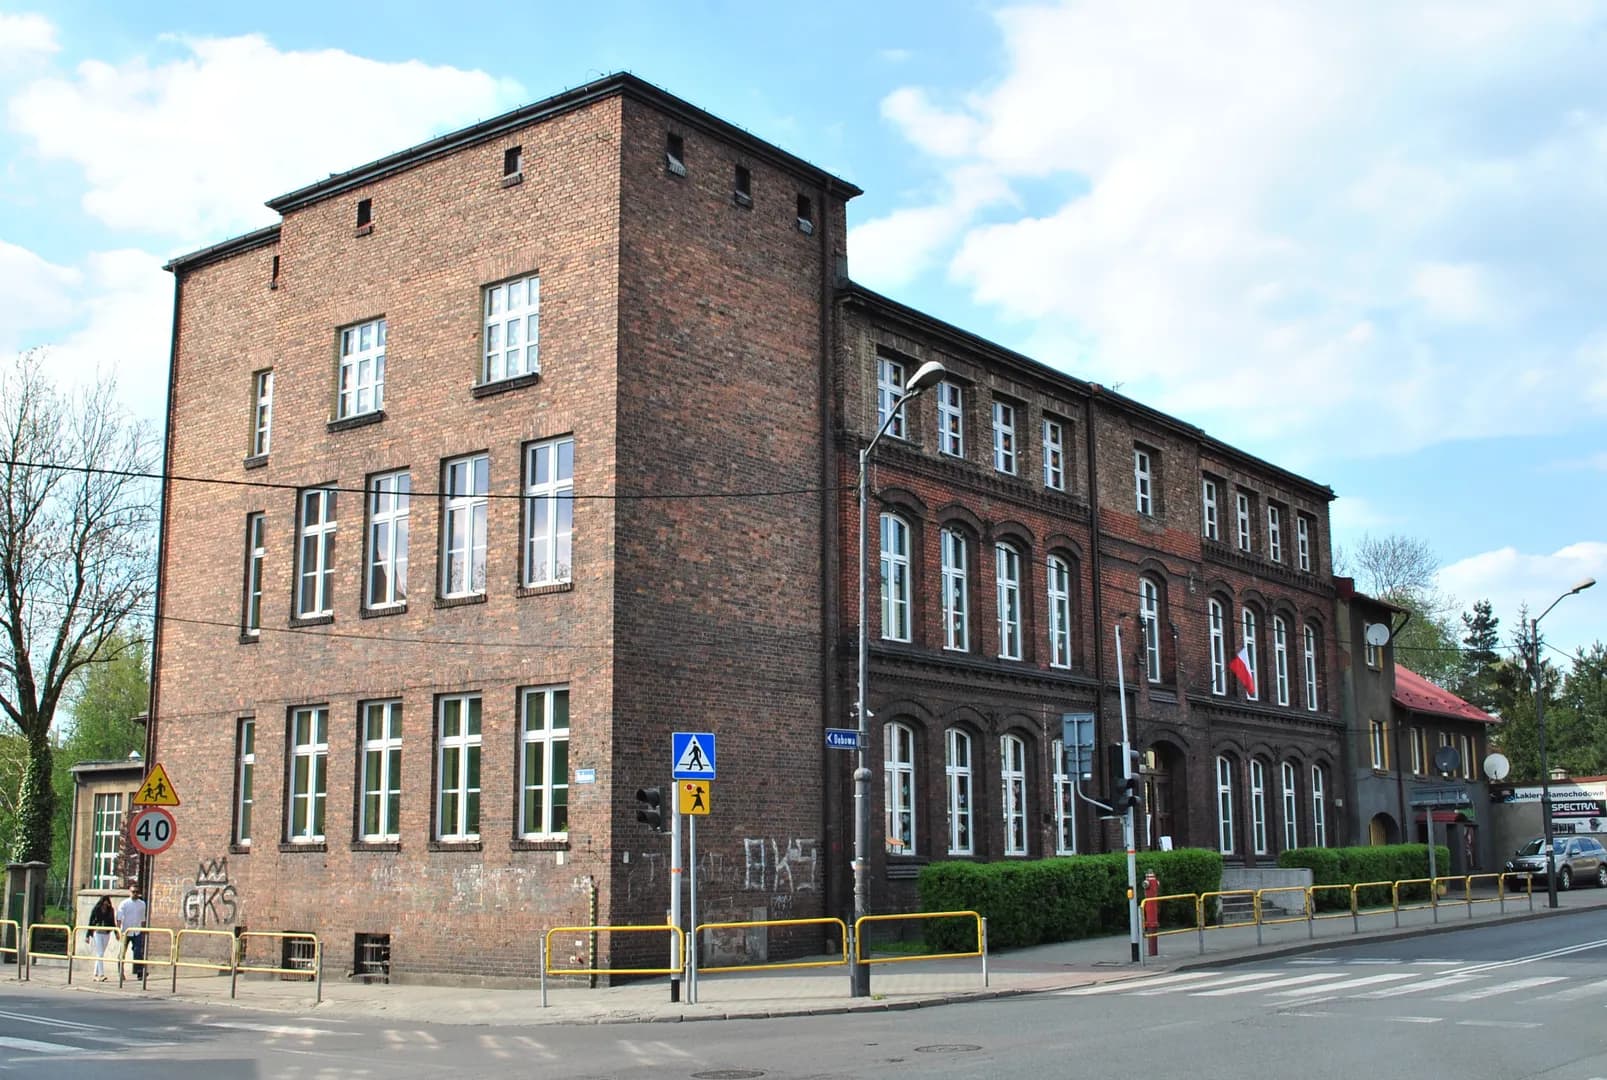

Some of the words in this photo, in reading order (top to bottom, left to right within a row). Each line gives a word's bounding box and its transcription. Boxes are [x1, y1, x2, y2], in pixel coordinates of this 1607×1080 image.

[1551, 802, 1599, 811] SPECTRAL
[136, 819, 170, 842] 40
[183, 884, 237, 926] GKS
